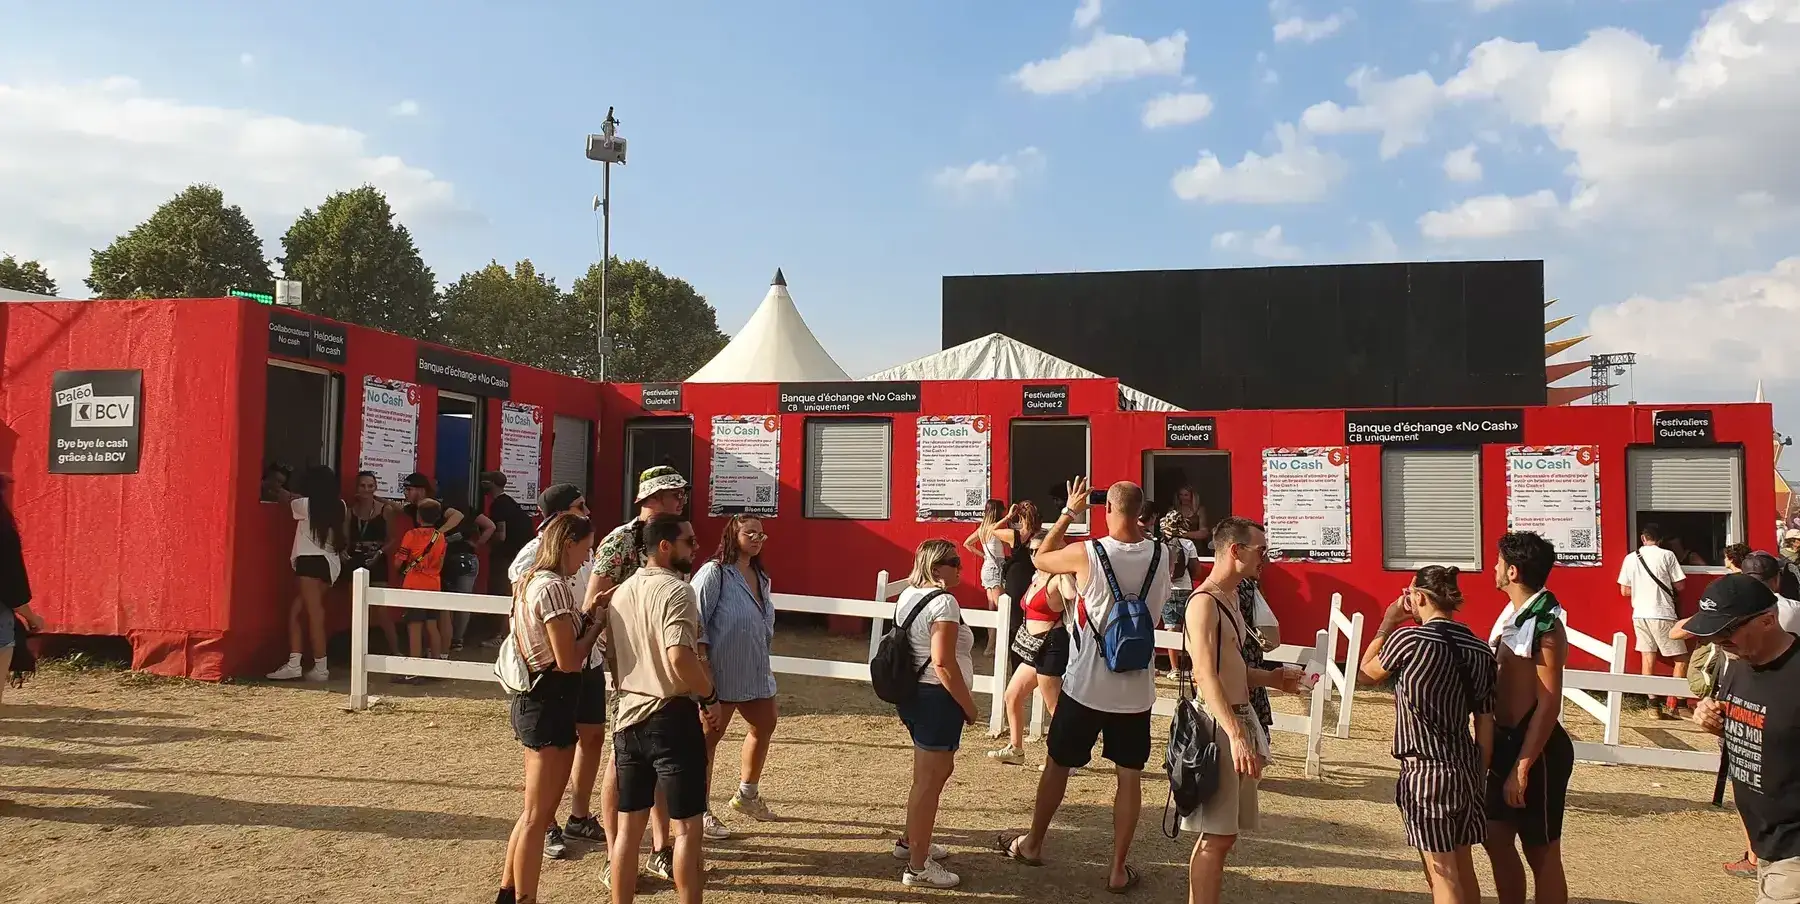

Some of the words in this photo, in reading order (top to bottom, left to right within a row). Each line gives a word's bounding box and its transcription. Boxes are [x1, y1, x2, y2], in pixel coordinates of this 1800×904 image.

[268, 322, 310, 338] Collaborateurs
[278, 335, 287, 344] No
[287, 337, 301, 346] cash
[313, 330, 344, 344] Helpdesk
[315, 343, 325, 353] No
[325, 346, 341, 356] cash
[419, 358, 444, 375] Banque
[444, 365, 477, 382] d'échange
[490, 375, 509, 388] Cash»
[57, 387, 91, 405] Paléo
[367, 389, 380, 402] No
[381, 391, 404, 407] Cash
[781, 393, 816, 404] Banque
[817, 392, 865, 404] d'échange
[866, 392, 886, 401] «No
[886, 391, 917, 401] Cash»
[1023, 391, 1066, 399] Festivaliers
[787, 404, 798, 412] CB
[804, 403, 850, 412] uniquement
[1026, 400, 1057, 408] Guichet
[1057, 400, 1063, 408] 2
[95, 403, 129, 420] BCV
[504, 412, 514, 424] No
[514, 414, 531, 426] Cash
[1655, 418, 1709, 426] Festivaliers
[716, 426, 731, 435] No
[733, 426, 760, 436] Cash
[922, 427, 938, 436] No
[940, 427, 968, 436] Cash
[1167, 423, 1212, 431] Festivaliers
[1348, 422, 1391, 435] Banque
[1393, 421, 1453, 434] d'échange
[1455, 421, 1479, 431] «No
[1481, 420, 1519, 431] Cash»
[1659, 429, 1697, 437] Guichet
[1698, 428, 1705, 437] 4
[1170, 433, 1202, 441] Guichet
[1203, 433, 1209, 441] 3
[1349, 434, 1362, 442] CB
[1364, 433, 1420, 443] uniquement
[57, 438, 76, 450] Bye
[77, 438, 94, 450] bye
[95, 438, 105, 448] le
[106, 438, 128, 448] cash
[58, 452, 86, 464] grâce
[87, 452, 93, 461] à
[94, 452, 103, 461] la
[105, 452, 126, 462] BCV
[1269, 460, 1287, 469] No
[1290, 459, 1323, 470] Cash
[1513, 459, 1533, 469] No
[1536, 459, 1571, 469] Cash
[1724, 718, 1744, 738] ANS
